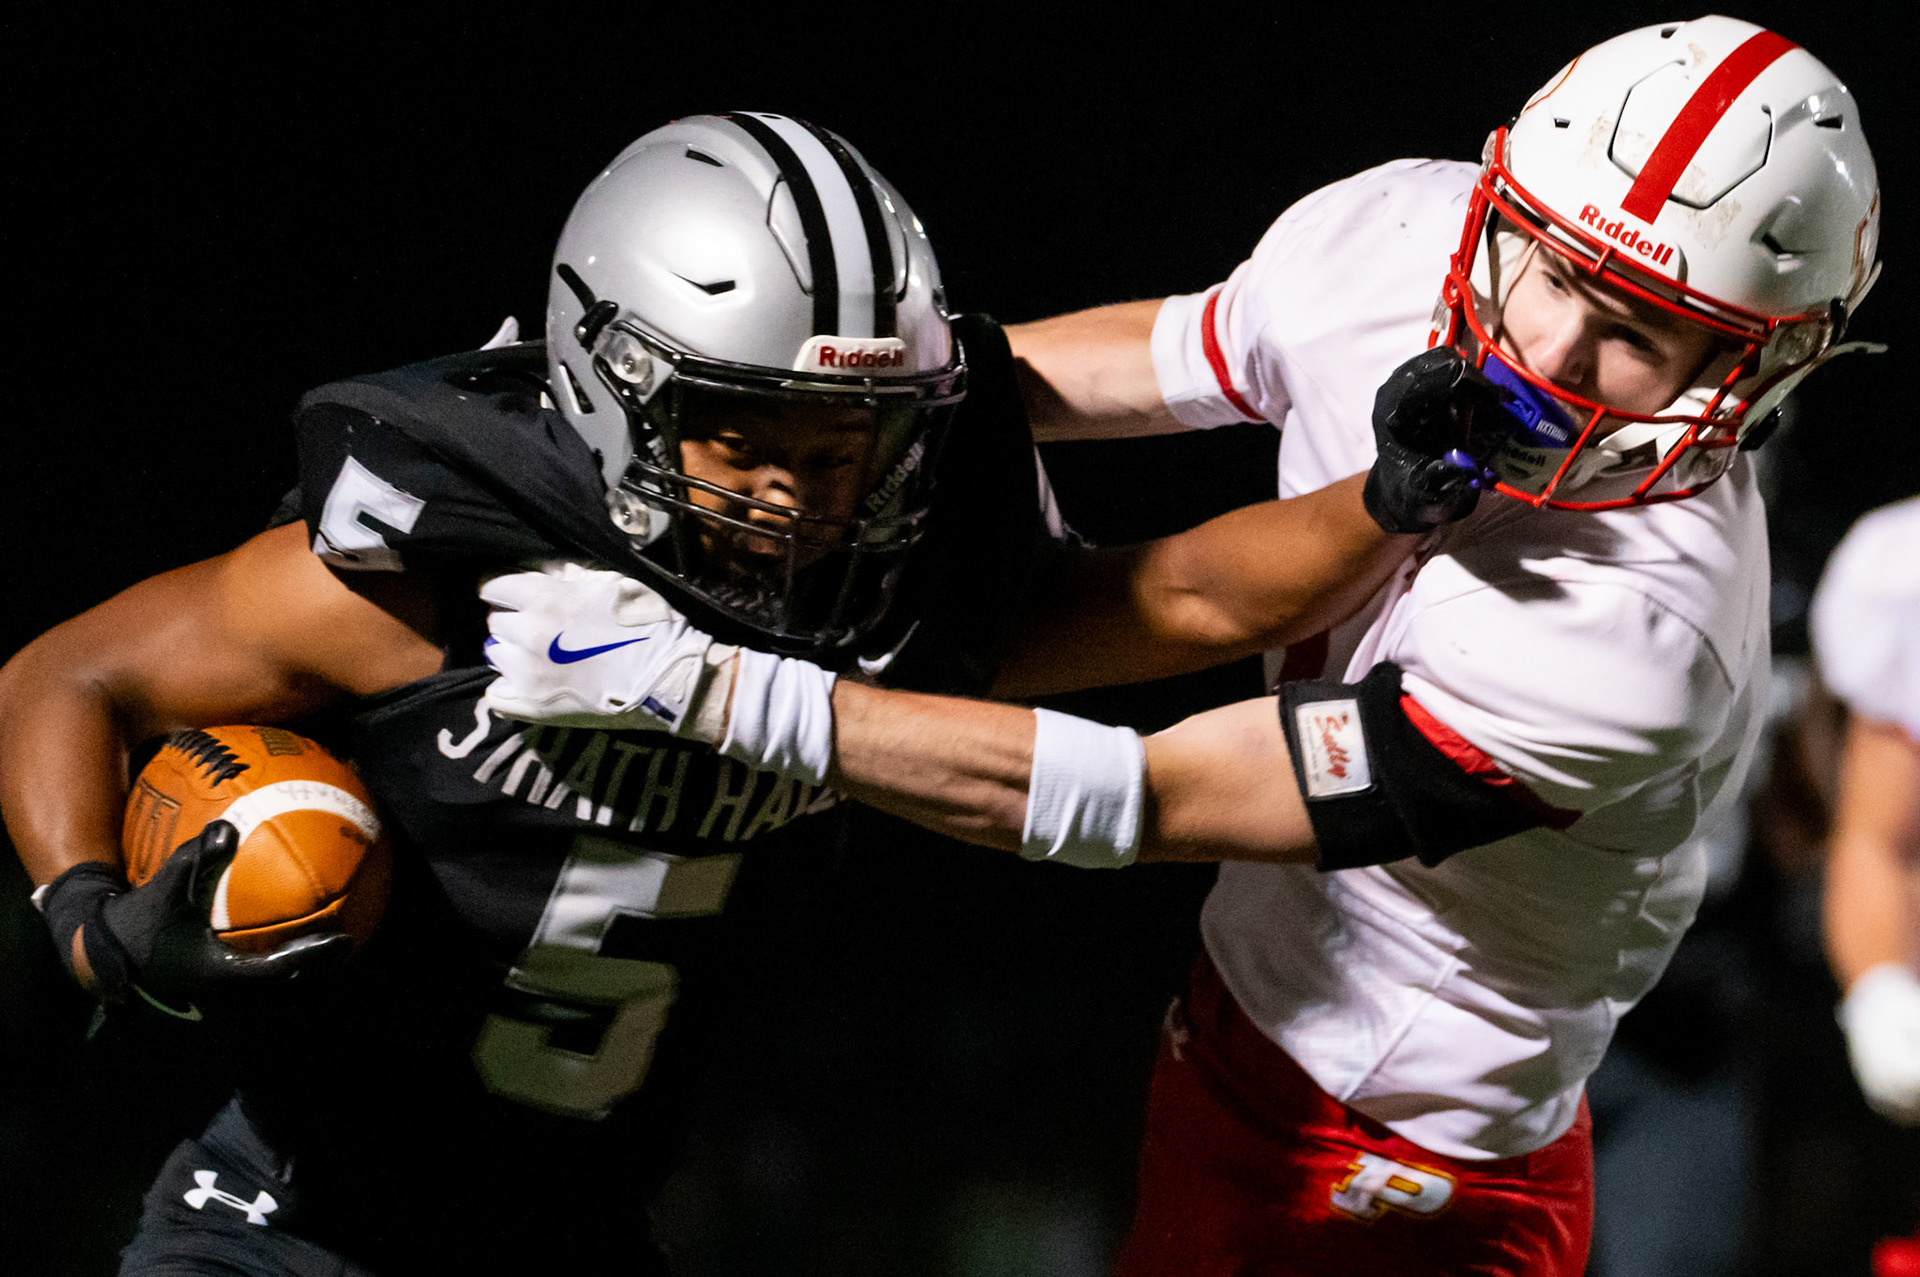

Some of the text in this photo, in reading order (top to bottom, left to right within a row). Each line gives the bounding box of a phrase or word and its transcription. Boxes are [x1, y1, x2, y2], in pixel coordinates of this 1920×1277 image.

[1578, 203, 1674, 267] Riddell
[819, 346, 905, 368] Riddell
[470, 833, 745, 1122] 5
